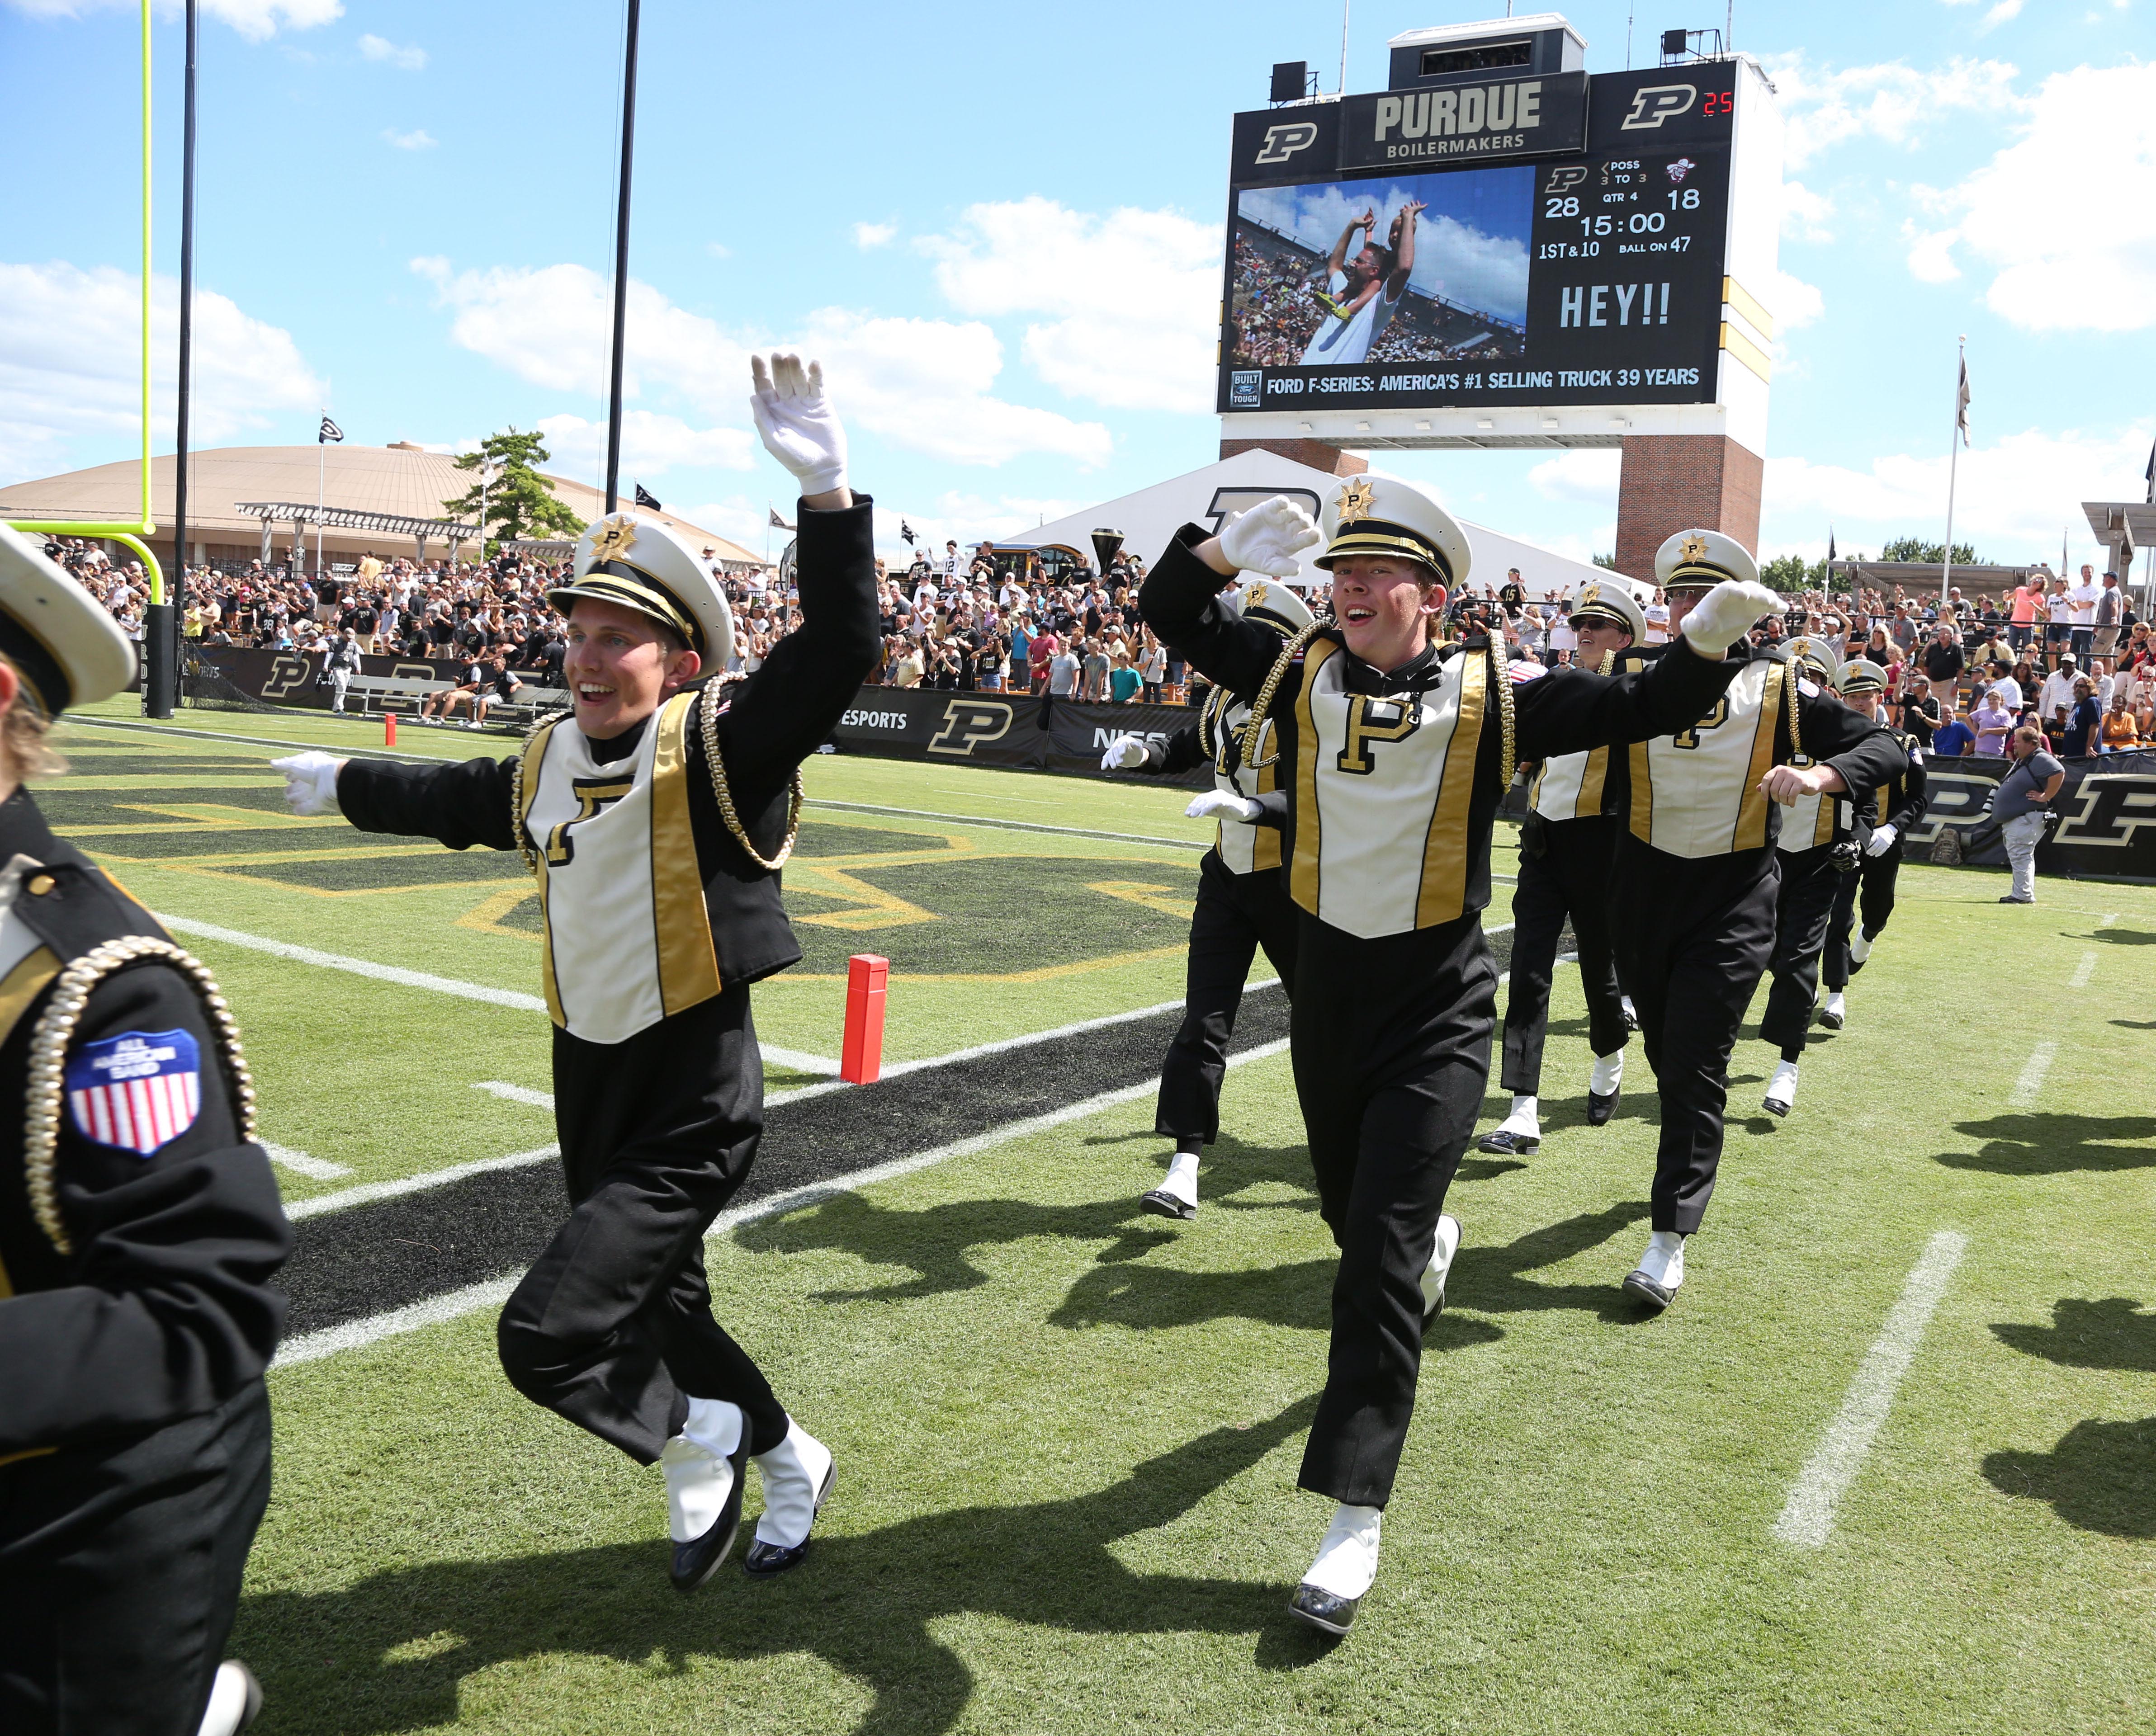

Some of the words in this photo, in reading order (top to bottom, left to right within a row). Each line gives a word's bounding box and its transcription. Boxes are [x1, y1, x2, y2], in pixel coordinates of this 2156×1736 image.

[1375, 81, 1541, 142] PURDUE
[1621, 84, 1697, 130] P
[1704, 92, 1732, 114] 25
[1254, 123, 1318, 164] P
[1387, 134, 1524, 158] BOILERMAKERS
[1611, 160, 1640, 170] POSS
[1544, 166, 1588, 193] P
[1601, 177, 1608, 185] 3
[1615, 175, 1630, 183] TO
[1639, 174, 1646, 182] 3
[1546, 197, 1580, 218] 28
[1603, 193, 1624, 203] QTR
[1630, 192, 1638, 201] 4
[1668, 189, 1700, 210] 18
[1581, 212, 1665, 236] 15:00
[1539, 243, 1566, 259] 1ST
[1569, 247, 1578, 257] &
[1581, 241, 1600, 257] 10
[1619, 244, 1646, 253] BALL
[1650, 243, 1667, 252] ON
[1670, 236, 1691, 252] 47
[1560, 283, 1670, 327] HEY!!
[1234, 375, 1258, 384] BUILT
[1267, 378, 1304, 394] FORD
[1308, 376, 1375, 393] F-SERIES:
[1378, 373, 1460, 392] AMERICA'S
[1464, 373, 1483, 389] #1
[1488, 371, 1552, 389] SELLING
[1558, 370, 1612, 387] TRUCK
[1617, 369, 1640, 386] 39
[1645, 368, 1699, 385] YEARS
[1348, 494, 1360, 506] P
[603, 531, 619, 543] P
[1688, 544, 1697, 553] P
[945, 561, 955, 573] 12
[1252, 590, 1259, 599] P
[1505, 589, 1516, 601] 15
[263, 619, 274, 630] 28
[260, 656, 310, 698] P
[841, 709, 907, 730] ESPORTS
[927, 699, 1013, 755] P
[1337, 692, 1423, 775] P
[116, 1037, 151, 1052] ALL
[92, 1045, 176, 1071] AMERICAN
[110, 1061, 161, 1080] BAND
